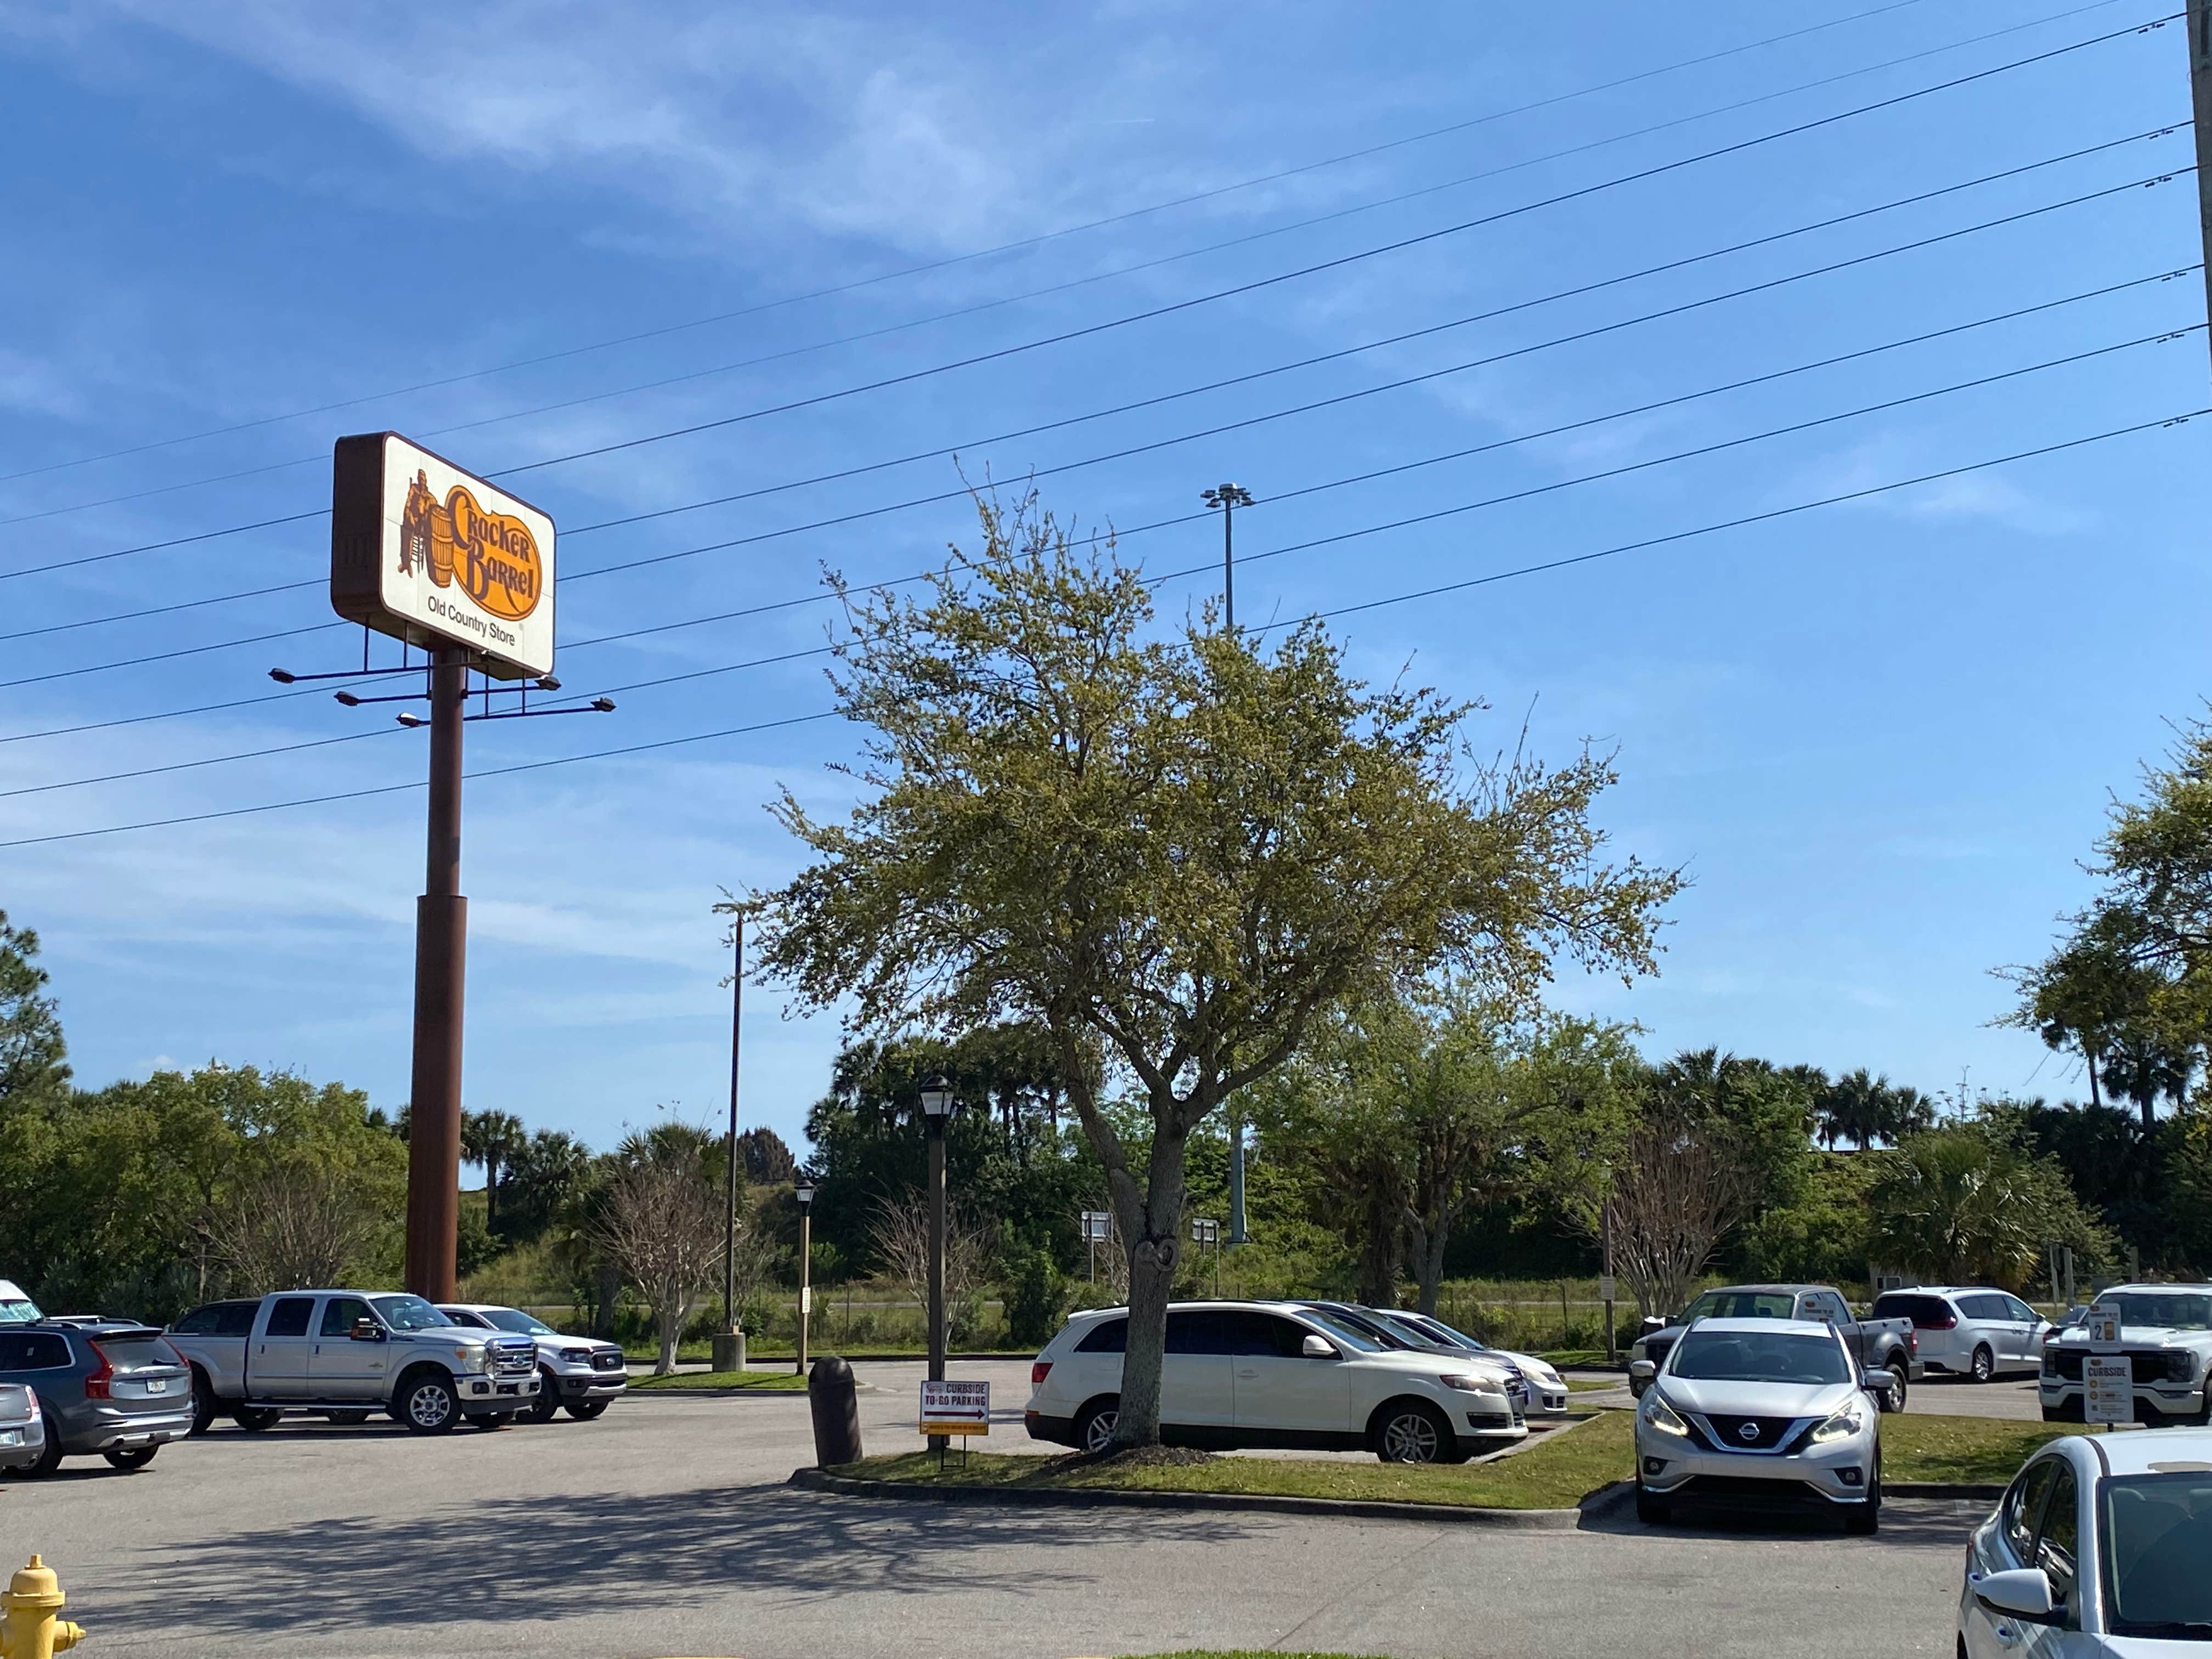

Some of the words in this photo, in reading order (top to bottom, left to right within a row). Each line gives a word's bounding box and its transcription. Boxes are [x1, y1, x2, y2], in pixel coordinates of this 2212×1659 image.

[447, 490, 531, 563] Cracker
[466, 533, 534, 614] Barrel
[428, 596, 445, 617] Old
[448, 605, 487, 637] Country
[489, 623, 515, 646] Store
[2095, 1325, 2102, 1340] 2
[2088, 1367, 2126, 1376] CURBSIDE
[946, 1384, 985, 1393] CURBSIDE
[951, 1396, 985, 1406] PARKING
